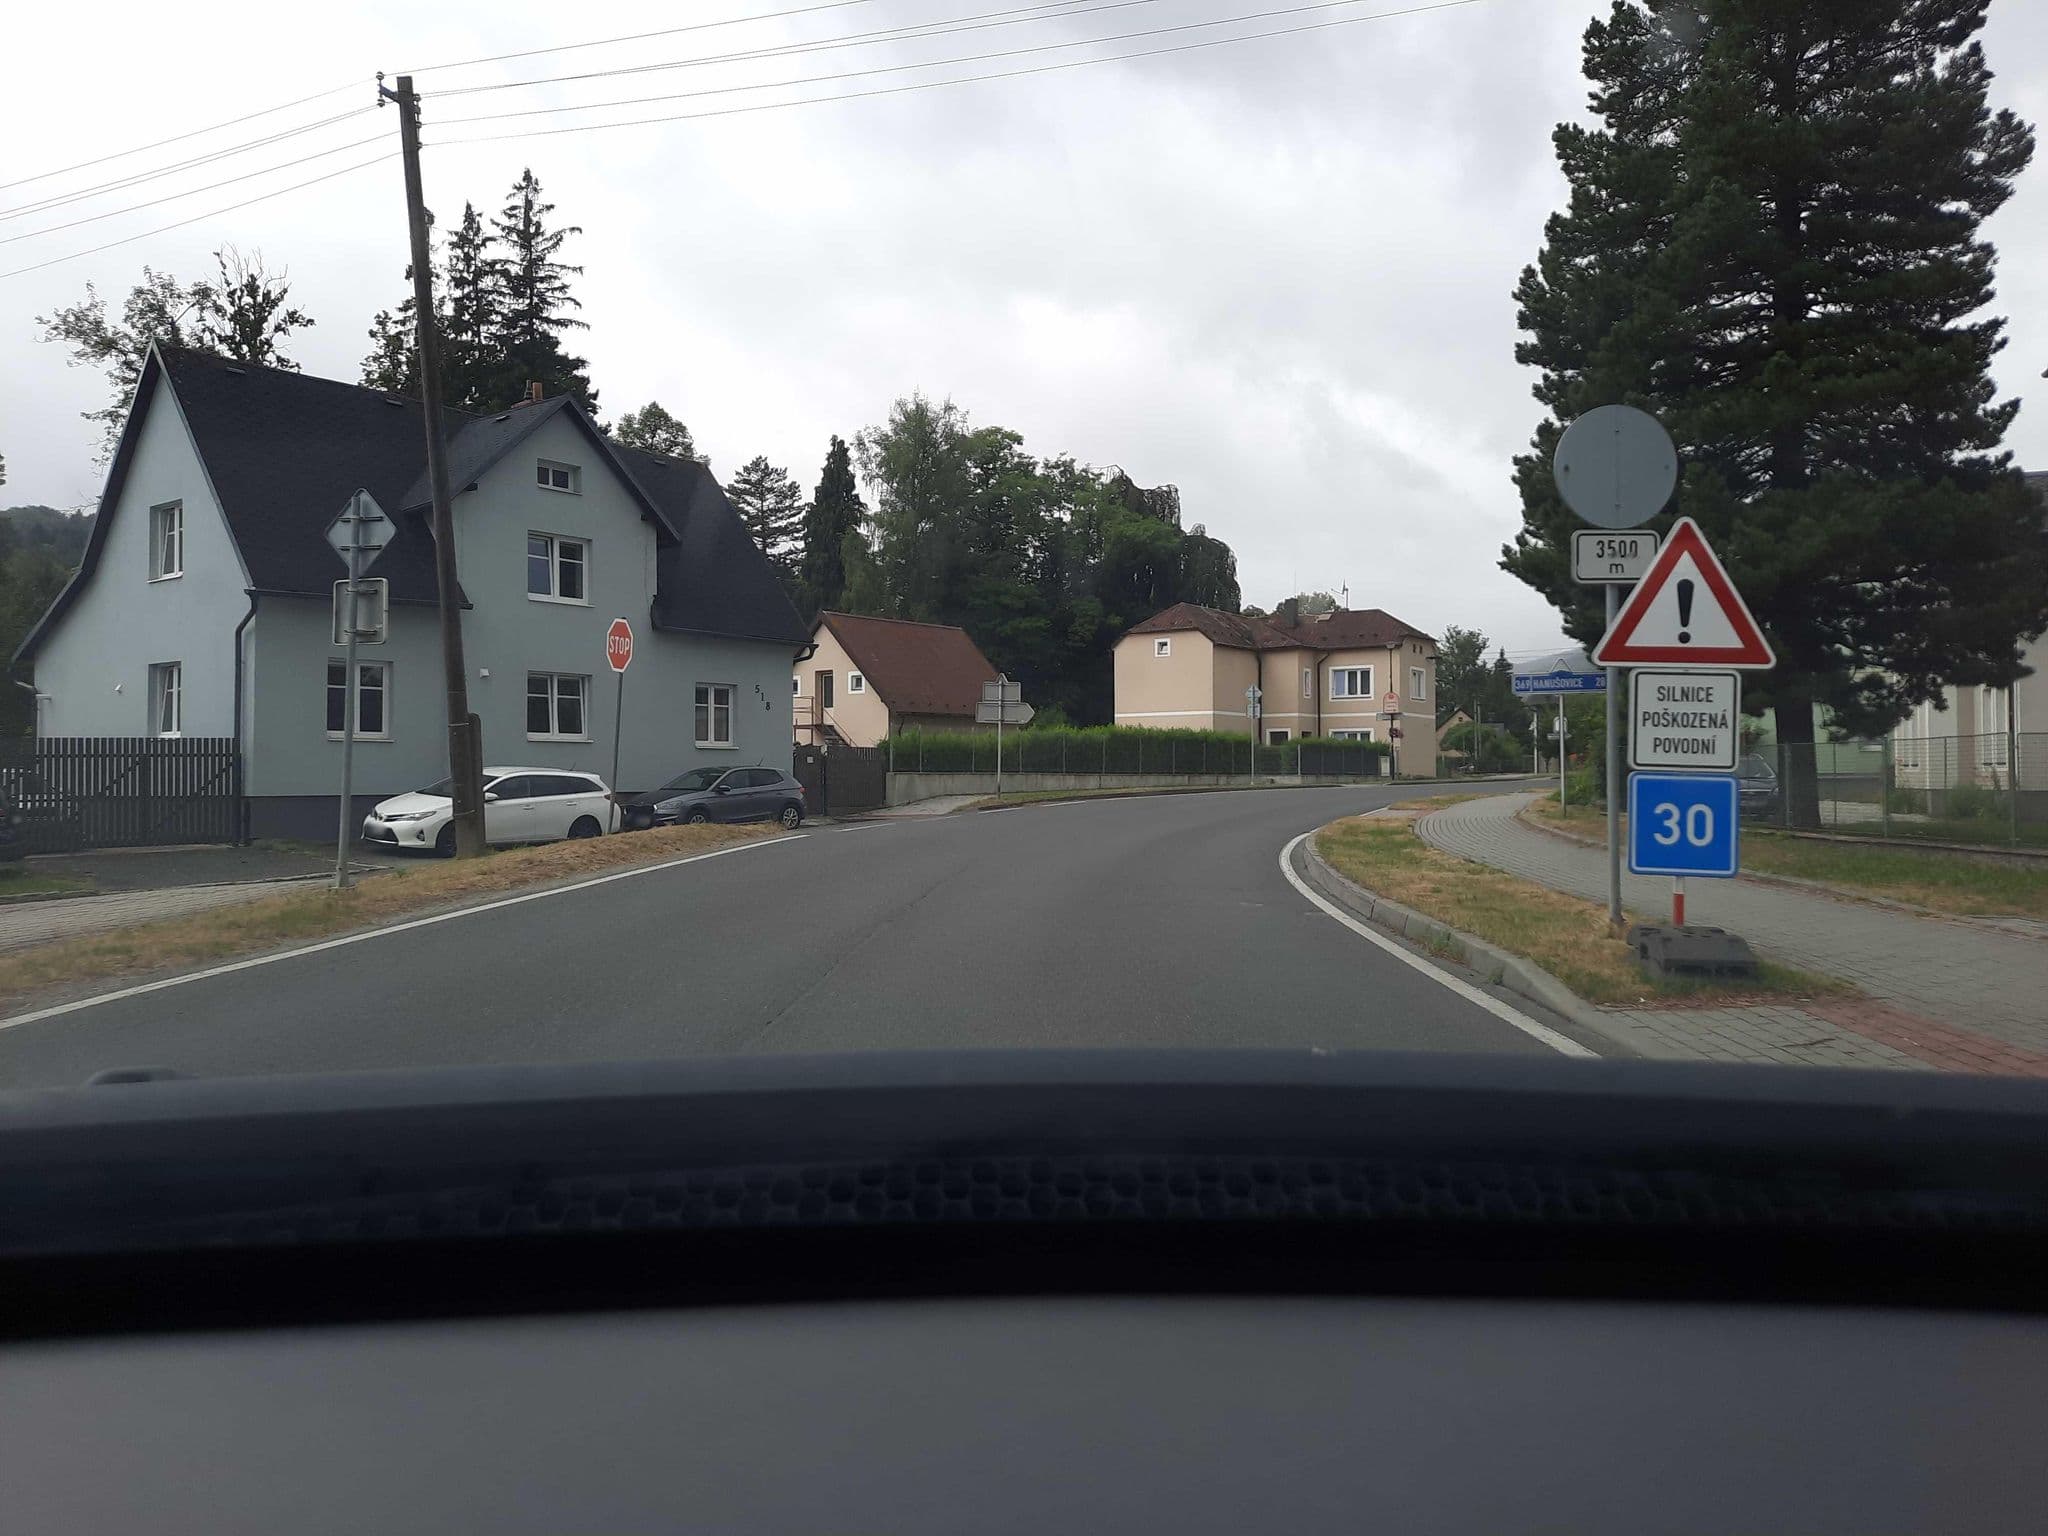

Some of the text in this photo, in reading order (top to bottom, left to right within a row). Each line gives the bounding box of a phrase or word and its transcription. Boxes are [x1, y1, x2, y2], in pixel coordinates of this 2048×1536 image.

[1596, 540, 1638, 559] 3500
[1609, 562, 1625, 574] m
[609, 636, 629, 655] STOP
[1514, 679, 1530, 689] 369
[1533, 677, 1583, 689] HANUŠOVICE
[1656, 686, 1714, 703] SILNICE
[1642, 708, 1728, 729] POŠKOZENÁ
[1652, 735, 1716, 755] POVODNÍ
[1653, 803, 1714, 847] 30
